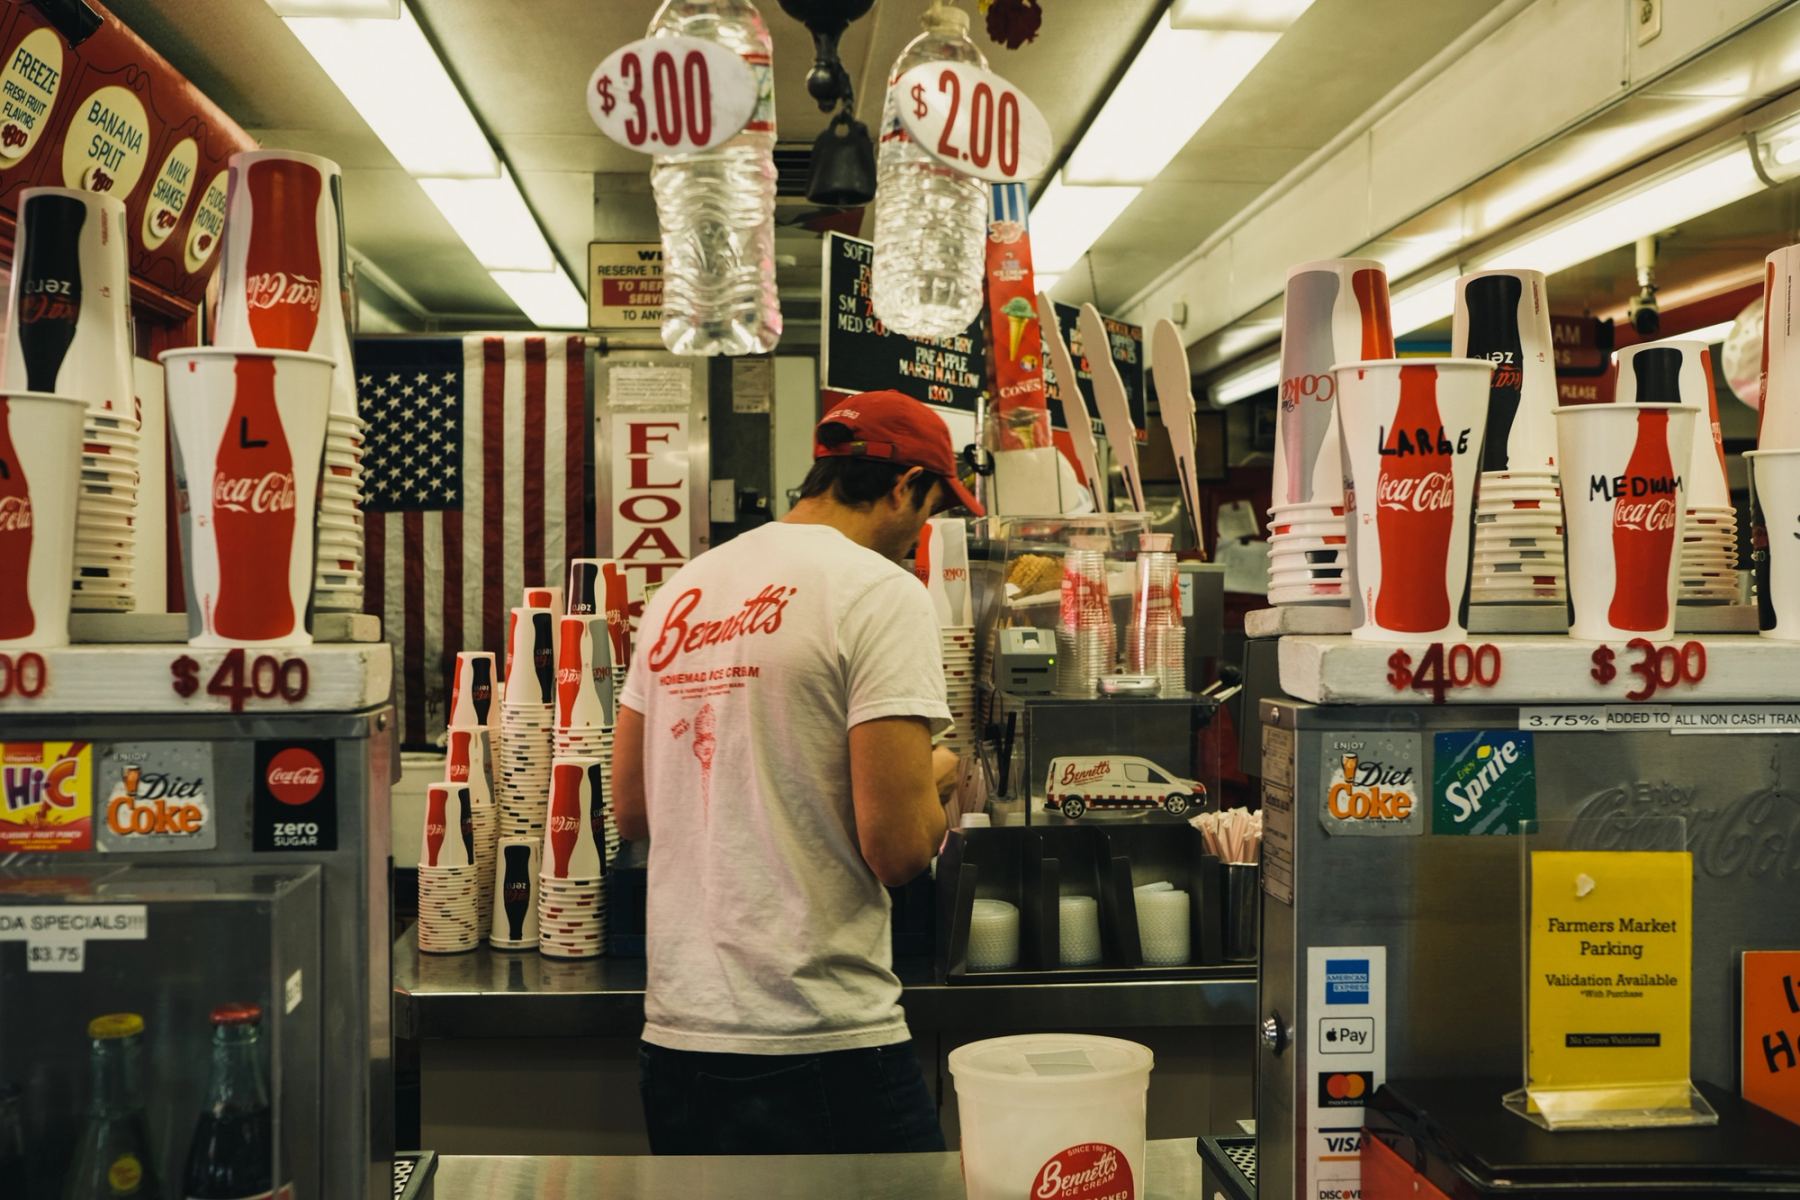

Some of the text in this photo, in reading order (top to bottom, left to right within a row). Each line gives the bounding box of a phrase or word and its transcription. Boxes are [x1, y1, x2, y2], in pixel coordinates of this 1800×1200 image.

[12, 47, 60, 95] FREEZE
[3, 80, 47, 117] FRESH FRUIT
[596, 51, 712, 146] $3.00
[2, 101, 36, 130] FLAVORS
[88, 99, 143, 154] BANANA
[913, 70, 1021, 177] $2.00
[88, 134, 126, 172] SPLIT
[166, 157, 191, 187] MILK
[153, 178, 186, 212] SHAKES
[195, 206, 224, 236] ROYALE
[843, 241, 873, 264] SOFT
[597, 265, 664, 276] RESERVE TH
[617, 281, 635, 292] TO
[622, 310, 637, 321] TO
[839, 294, 857, 314] SM
[838, 313, 864, 334] MED
[916, 346, 968, 373] PINEAPPLE
[1000, 382, 1041, 399] CONES
[1281, 374, 1336, 405] Coke
[1560, 384, 1598, 400] PLEASE
[239, 416, 269, 449] L
[1377, 425, 1471, 458] LARGE
[213, 471, 296, 514] Coca-Cola
[1377, 471, 1454, 512] Coca-Cola
[1614, 498, 1676, 531] Coca-Cola
[1528, 714, 1600, 727] 3.75%
[1606, 713, 1650, 724] ADDED
[1653, 713, 1670, 723] TO
[1675, 713, 1697, 725] ALL
[1701, 713, 1728, 725] NON
[1732, 713, 1766, 725] CASH
[112, 751, 148, 763] ENJOY
[1334, 742, 1366, 750] ENJOY
[4, 757, 79, 812] Hi-C
[138, 772, 204, 800] Diet
[269, 768, 323, 786] Coca-Cola
[1353, 761, 1413, 787] Diet
[1445, 740, 1519, 823] Sprite
[1328, 783, 1412, 820] Coke
[1633, 780, 1696, 807] Enjoy
[107, 795, 204, 836] Coke
[273, 822, 319, 837] zero
[274, 835, 318, 847] SUGAR
[0, 916, 26, 931] DA
[1548, 917, 1677, 933] Farmers Market
[29, 946, 80, 962] $3.75
[1580, 940, 1643, 960] Parking
[1326, 974, 1366, 982] AMERICAN
[1334, 983, 1369, 992] EXPRESS
[1545, 974, 1678, 987] Validation Available
[1606, 989, 1643, 998] Purchase
[1340, 1028, 1367, 1046] Pay
[1568, 1036, 1582, 1044] No
[1067, 1145, 1090, 1157] SINCE
[1037, 1149, 1118, 1199] Bennett's
[1062, 1172, 1115, 1198] ICE CREAM
[1319, 1189, 1361, 1200] DISCOVE
